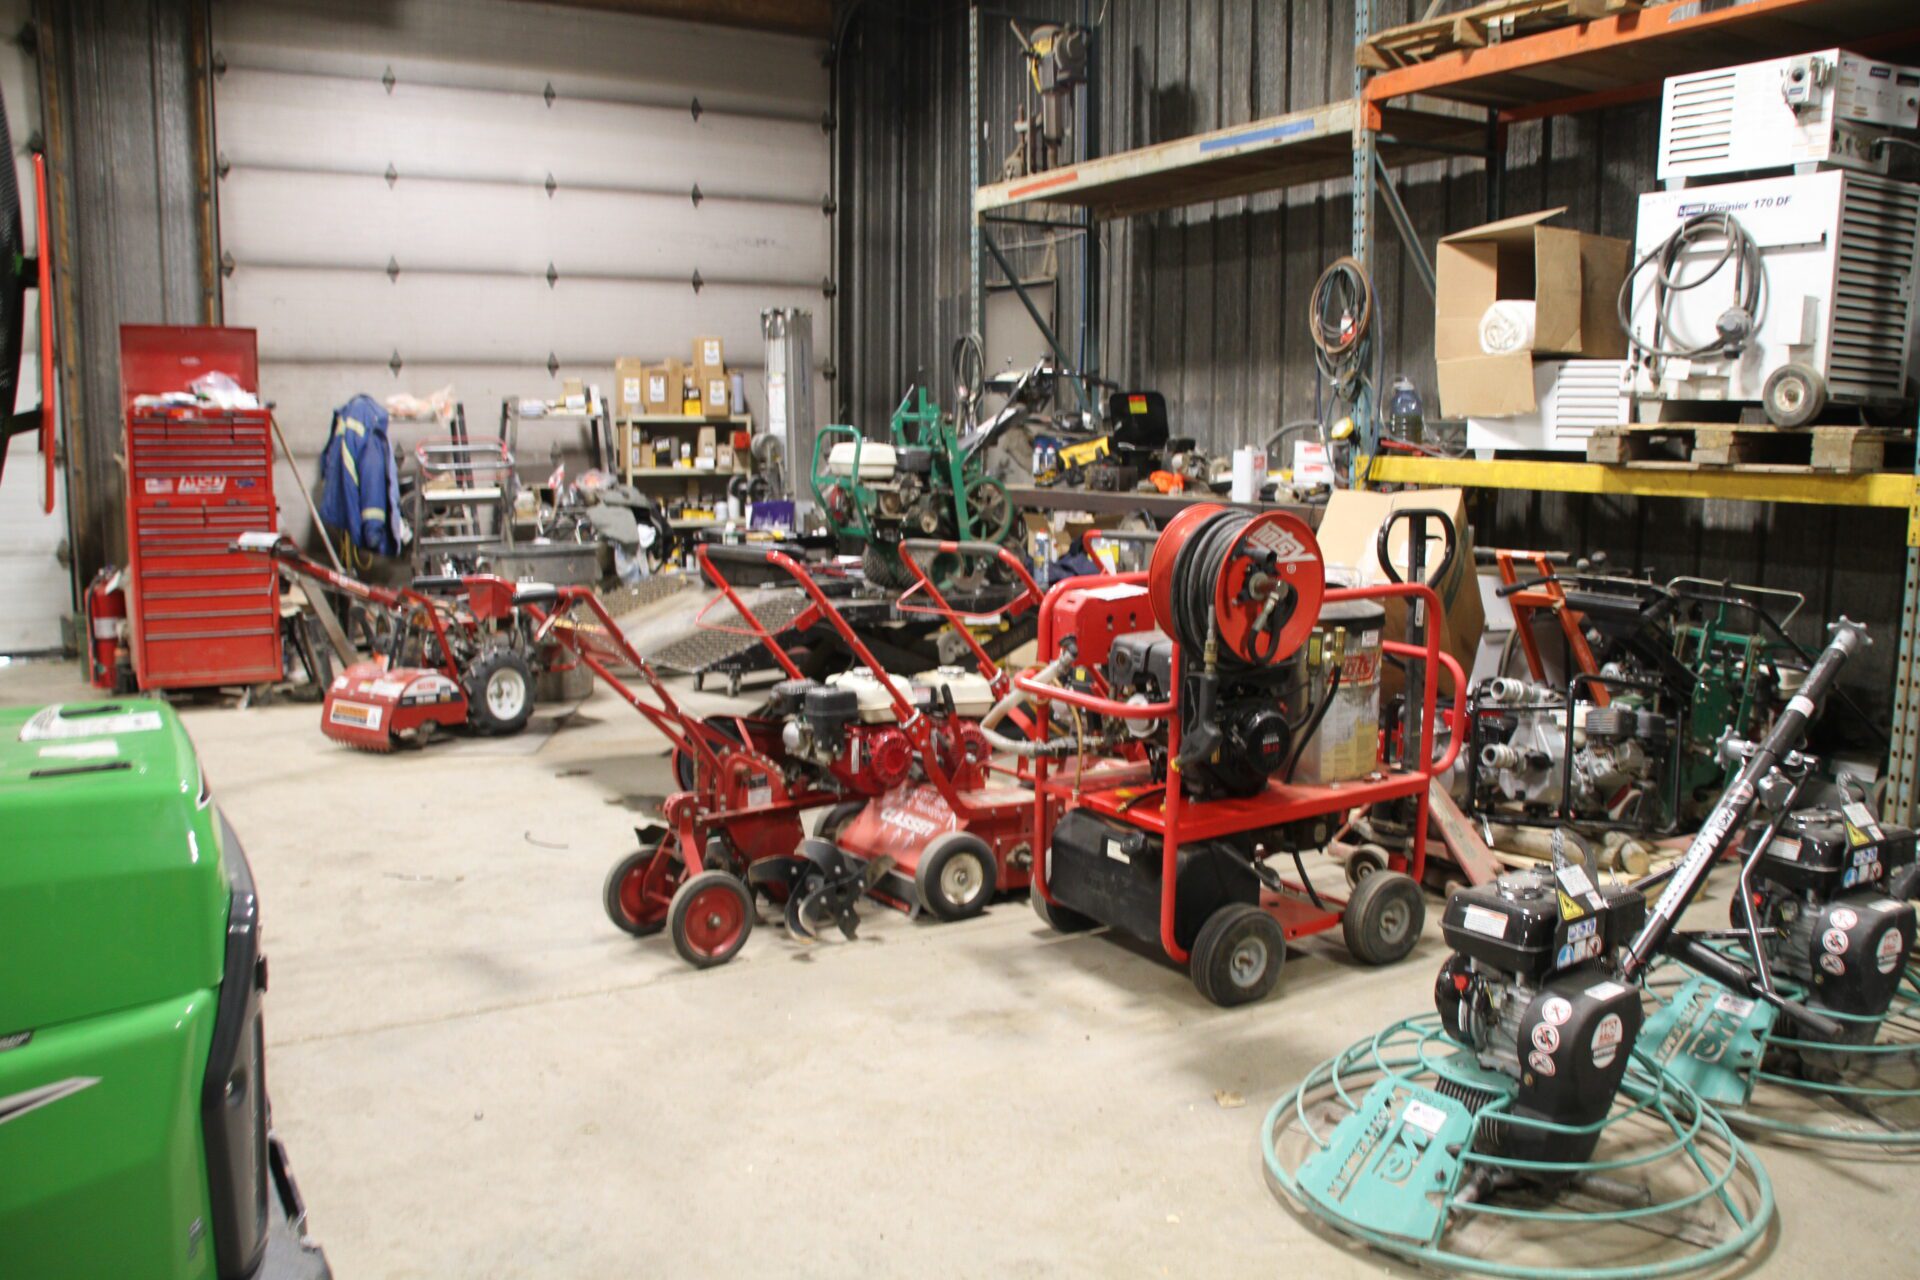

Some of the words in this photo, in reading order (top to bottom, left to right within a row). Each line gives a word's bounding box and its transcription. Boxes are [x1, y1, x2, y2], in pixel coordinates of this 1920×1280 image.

[1707, 202, 1749, 213] Premier
[1754, 198, 1773, 209] 170
[1775, 196, 1792, 207] DF
